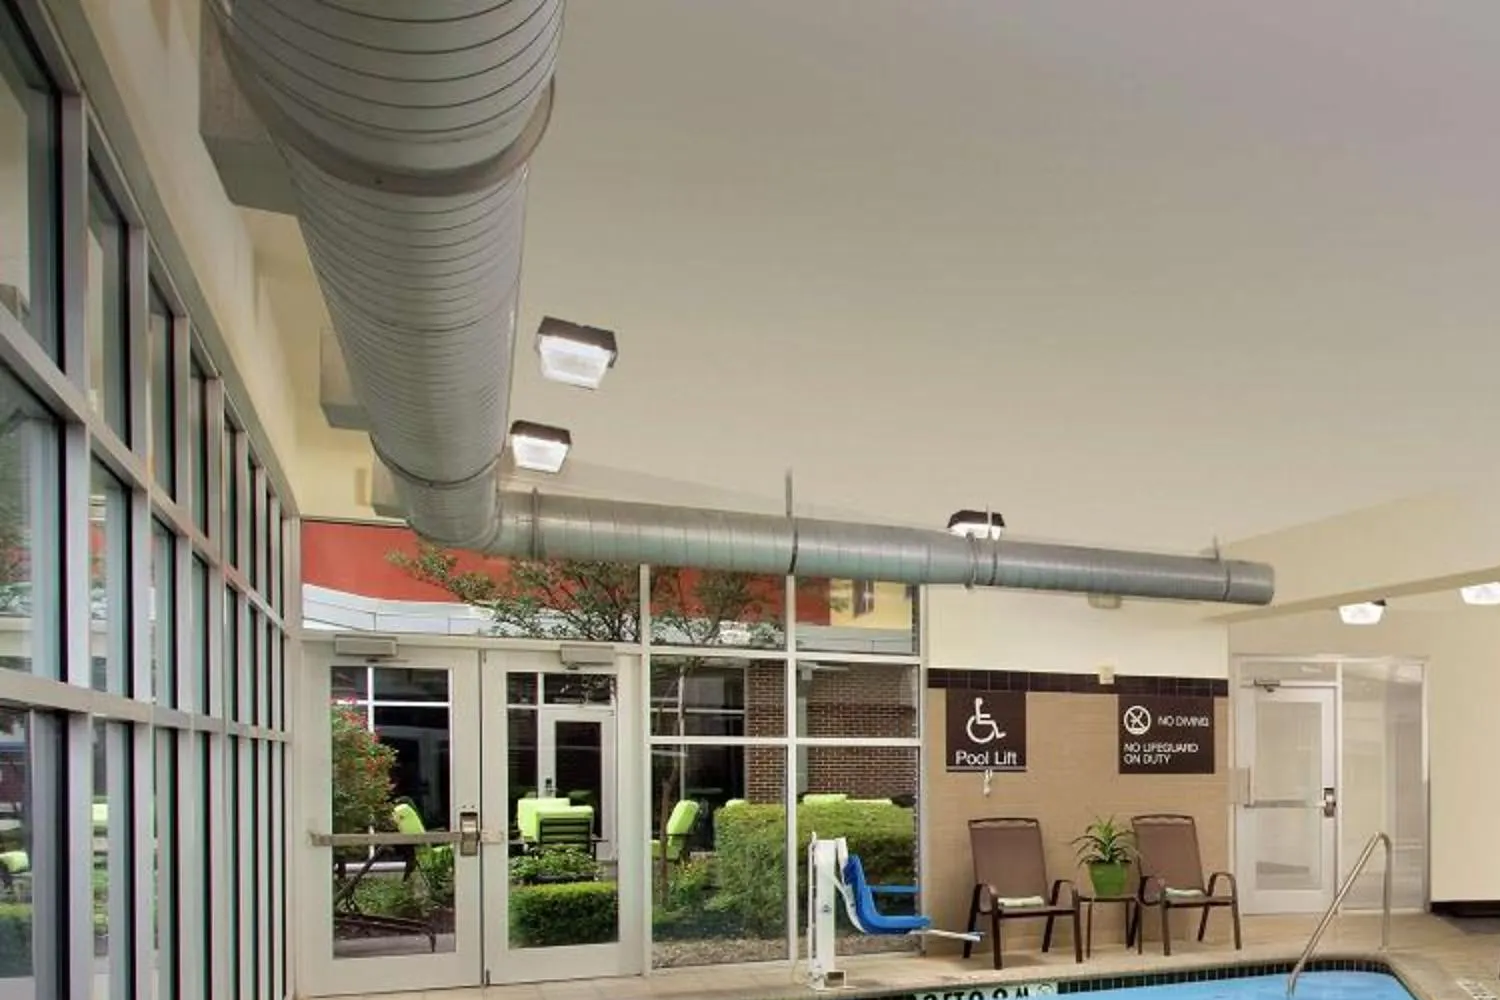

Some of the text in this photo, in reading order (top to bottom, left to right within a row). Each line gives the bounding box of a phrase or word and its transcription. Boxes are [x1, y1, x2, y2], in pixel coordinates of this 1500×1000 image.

[1157, 715, 1209, 727] NO DIVING
[1124, 742, 1199, 753] NO LIFEGUARD
[955, 750, 1017, 766] Pool Lift
[1124, 754, 1171, 765] ON DUTY
